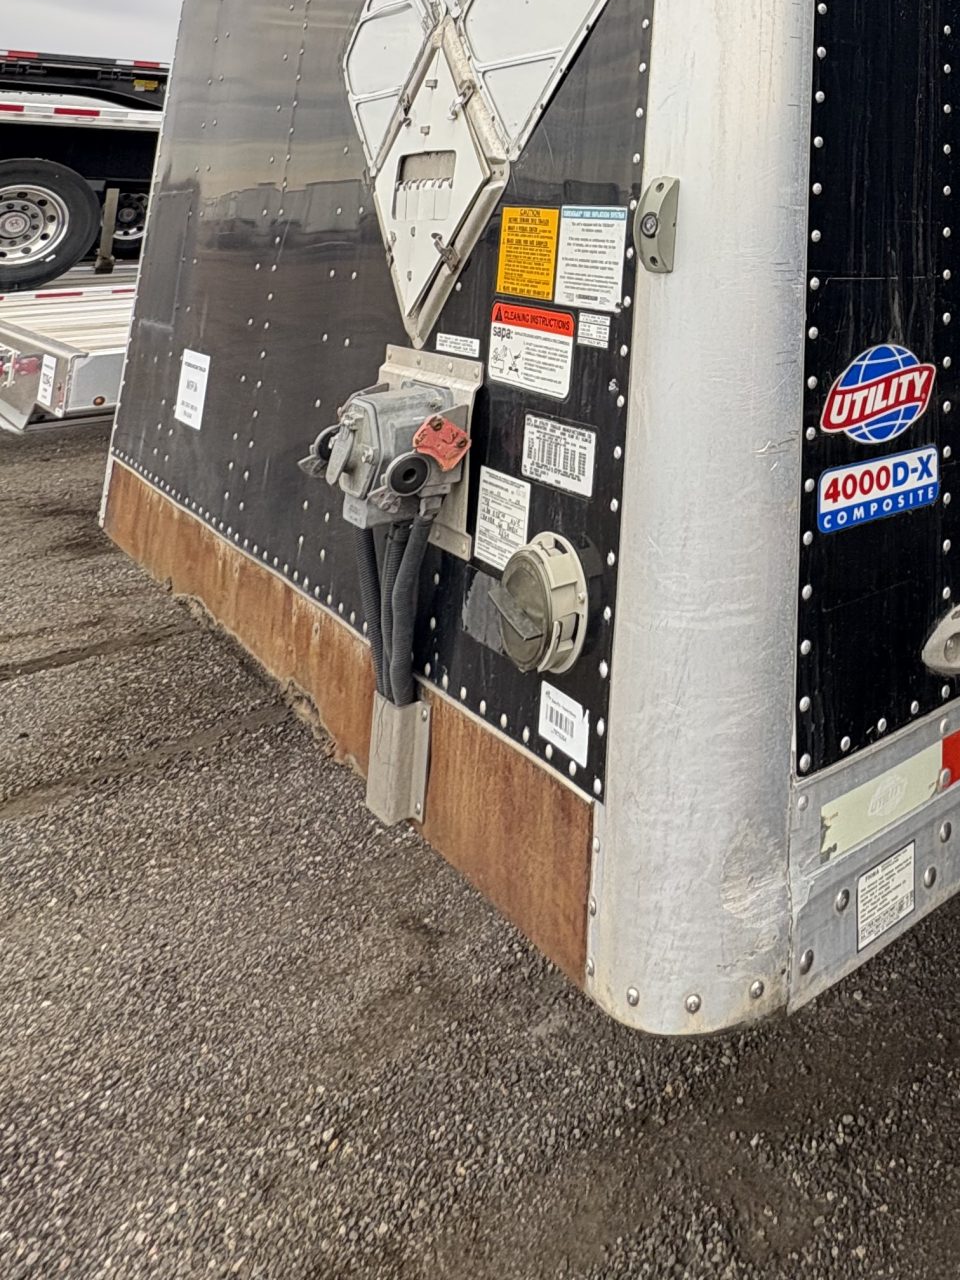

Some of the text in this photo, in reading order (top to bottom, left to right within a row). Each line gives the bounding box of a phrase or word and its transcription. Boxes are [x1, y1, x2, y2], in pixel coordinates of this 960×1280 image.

[504, 310, 529, 323] CLEANING
[530, 314, 570, 330] INSTRUCTIONS
[830, 371, 930, 424] UTILITY
[824, 454, 934, 503] 4000D-X
[823, 486, 934, 529] COMPOSITE
